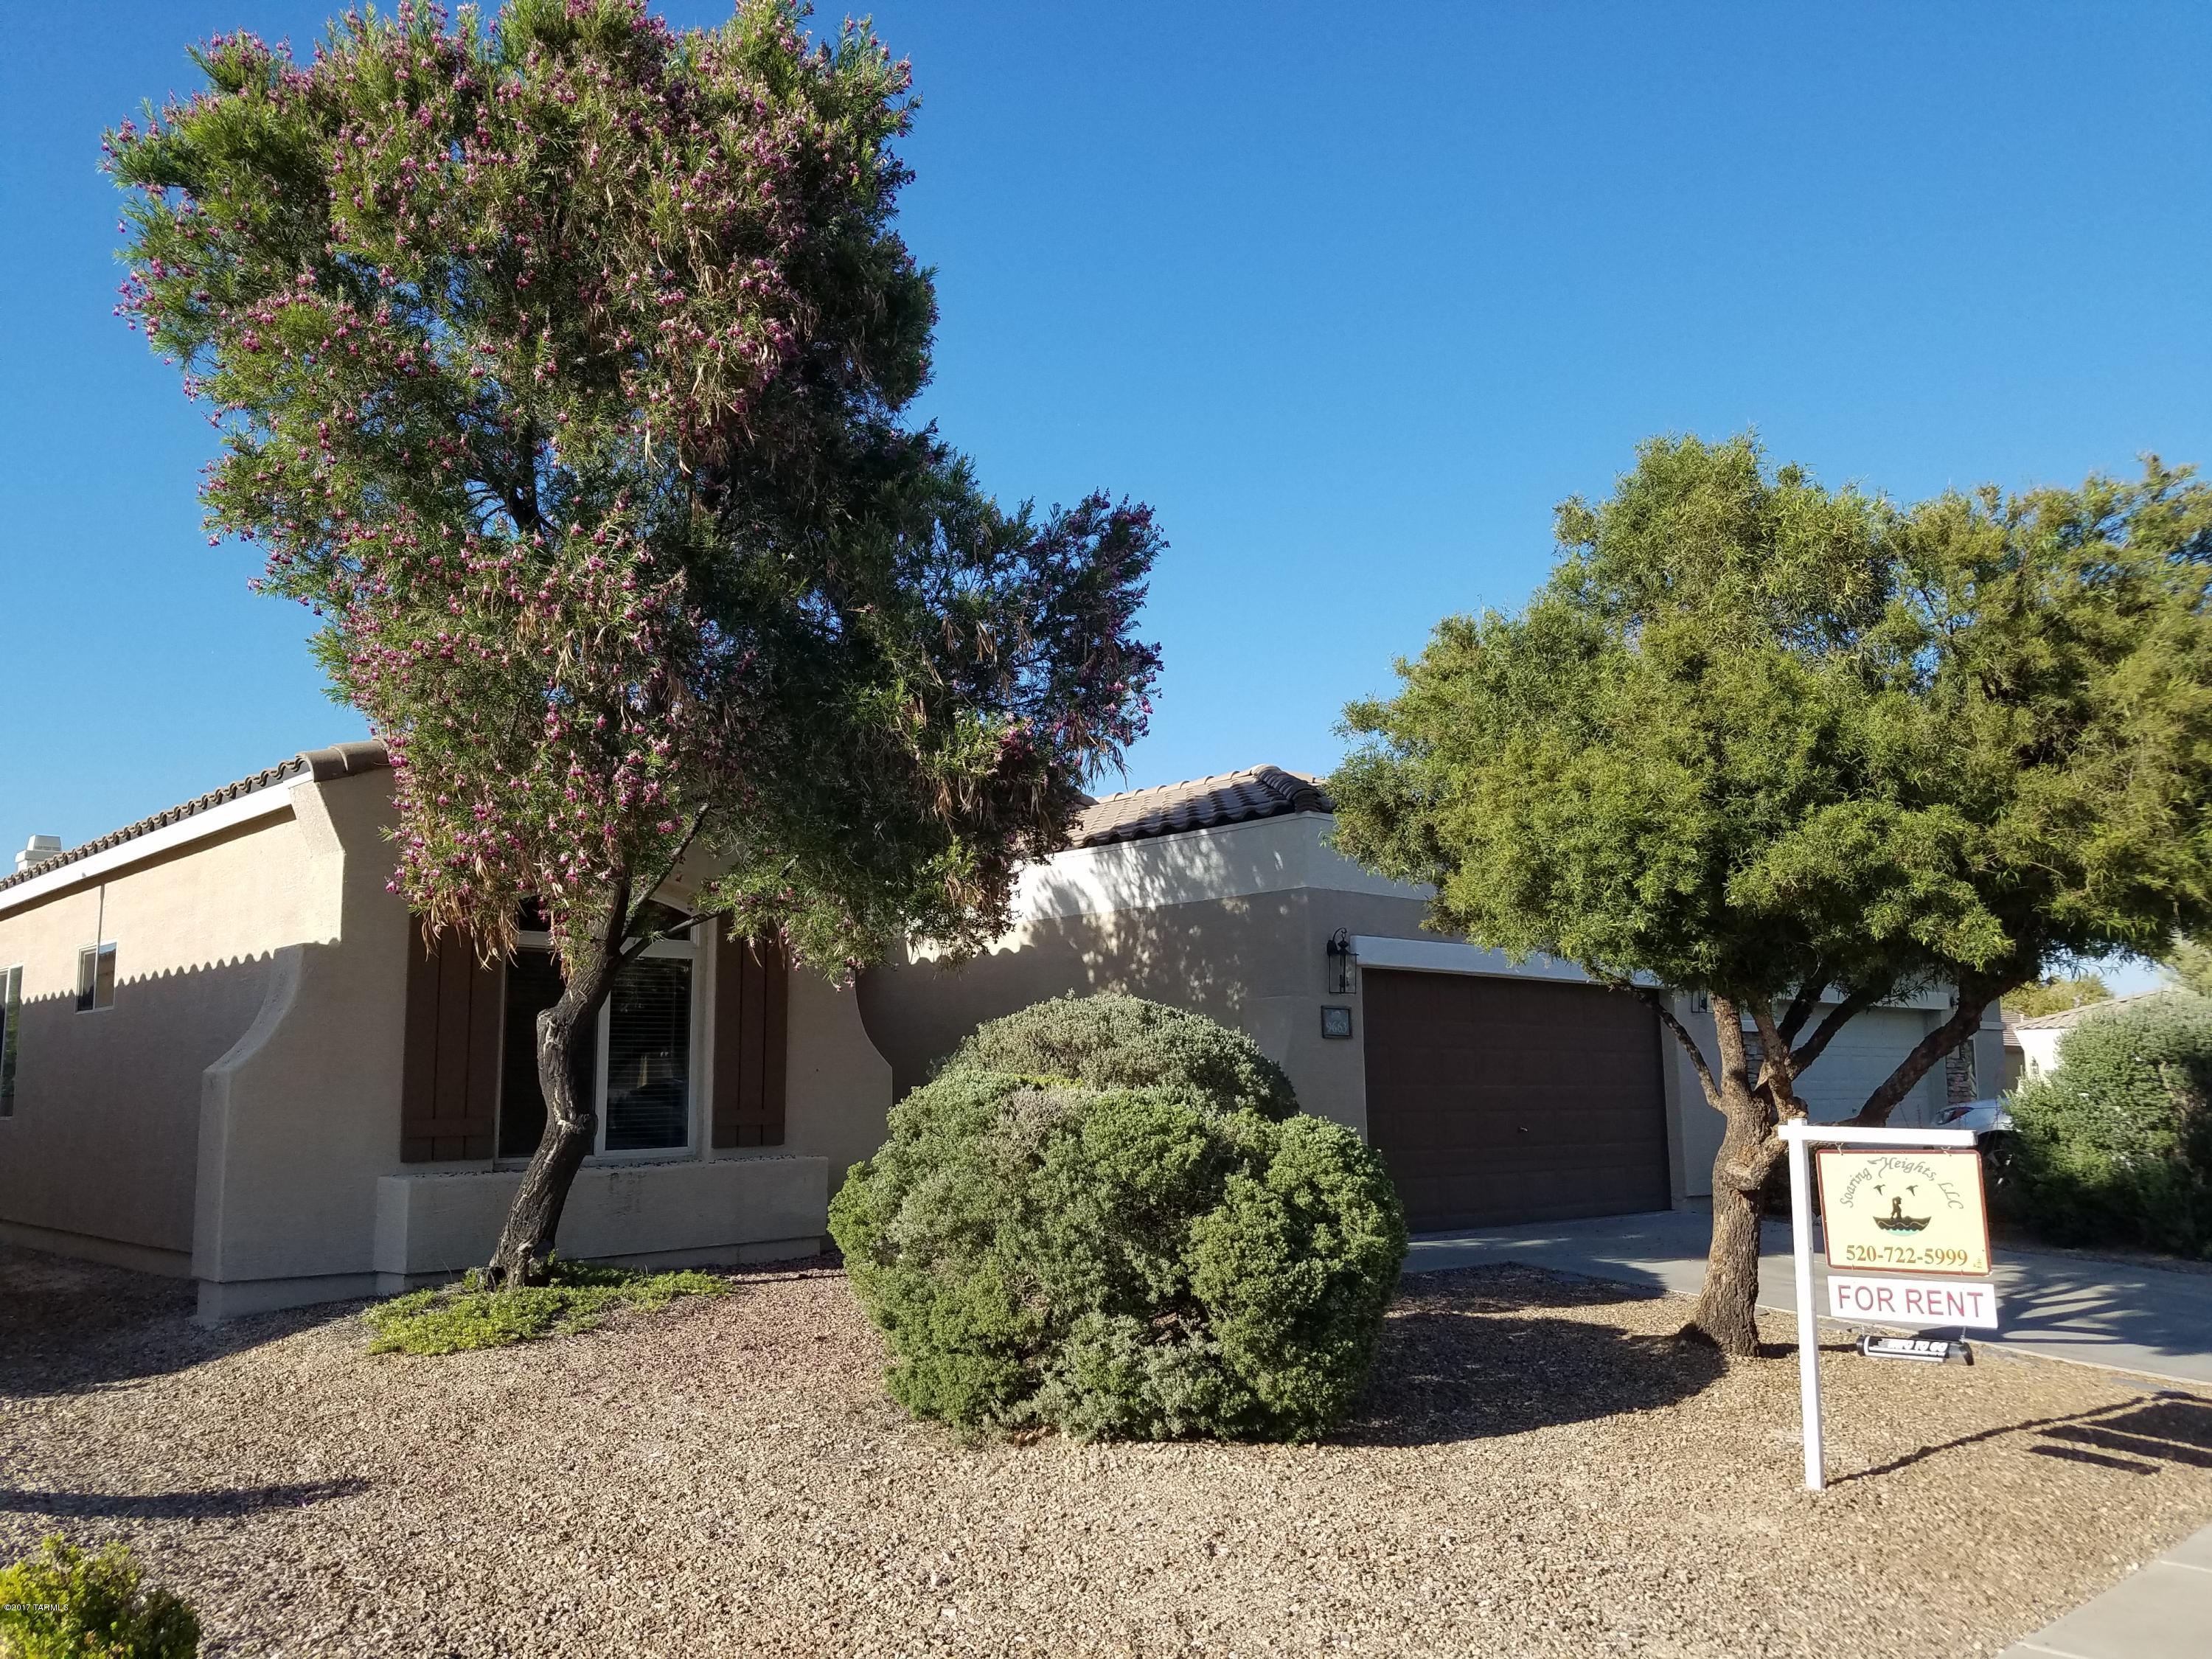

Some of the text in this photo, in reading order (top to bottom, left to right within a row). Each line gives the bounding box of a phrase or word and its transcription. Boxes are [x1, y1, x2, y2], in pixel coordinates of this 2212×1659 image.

[1325, 1021, 1348, 1033] 9663
[1840, 1156, 1964, 1209] Soaring Heights, LLC
[1846, 1245, 1968, 1266] 520-722-5999
[1837, 1285, 1983, 1318] FOR RENT
[1914, 1340, 1930, 1350] TO
[1930, 1341, 1948, 1352] GO
